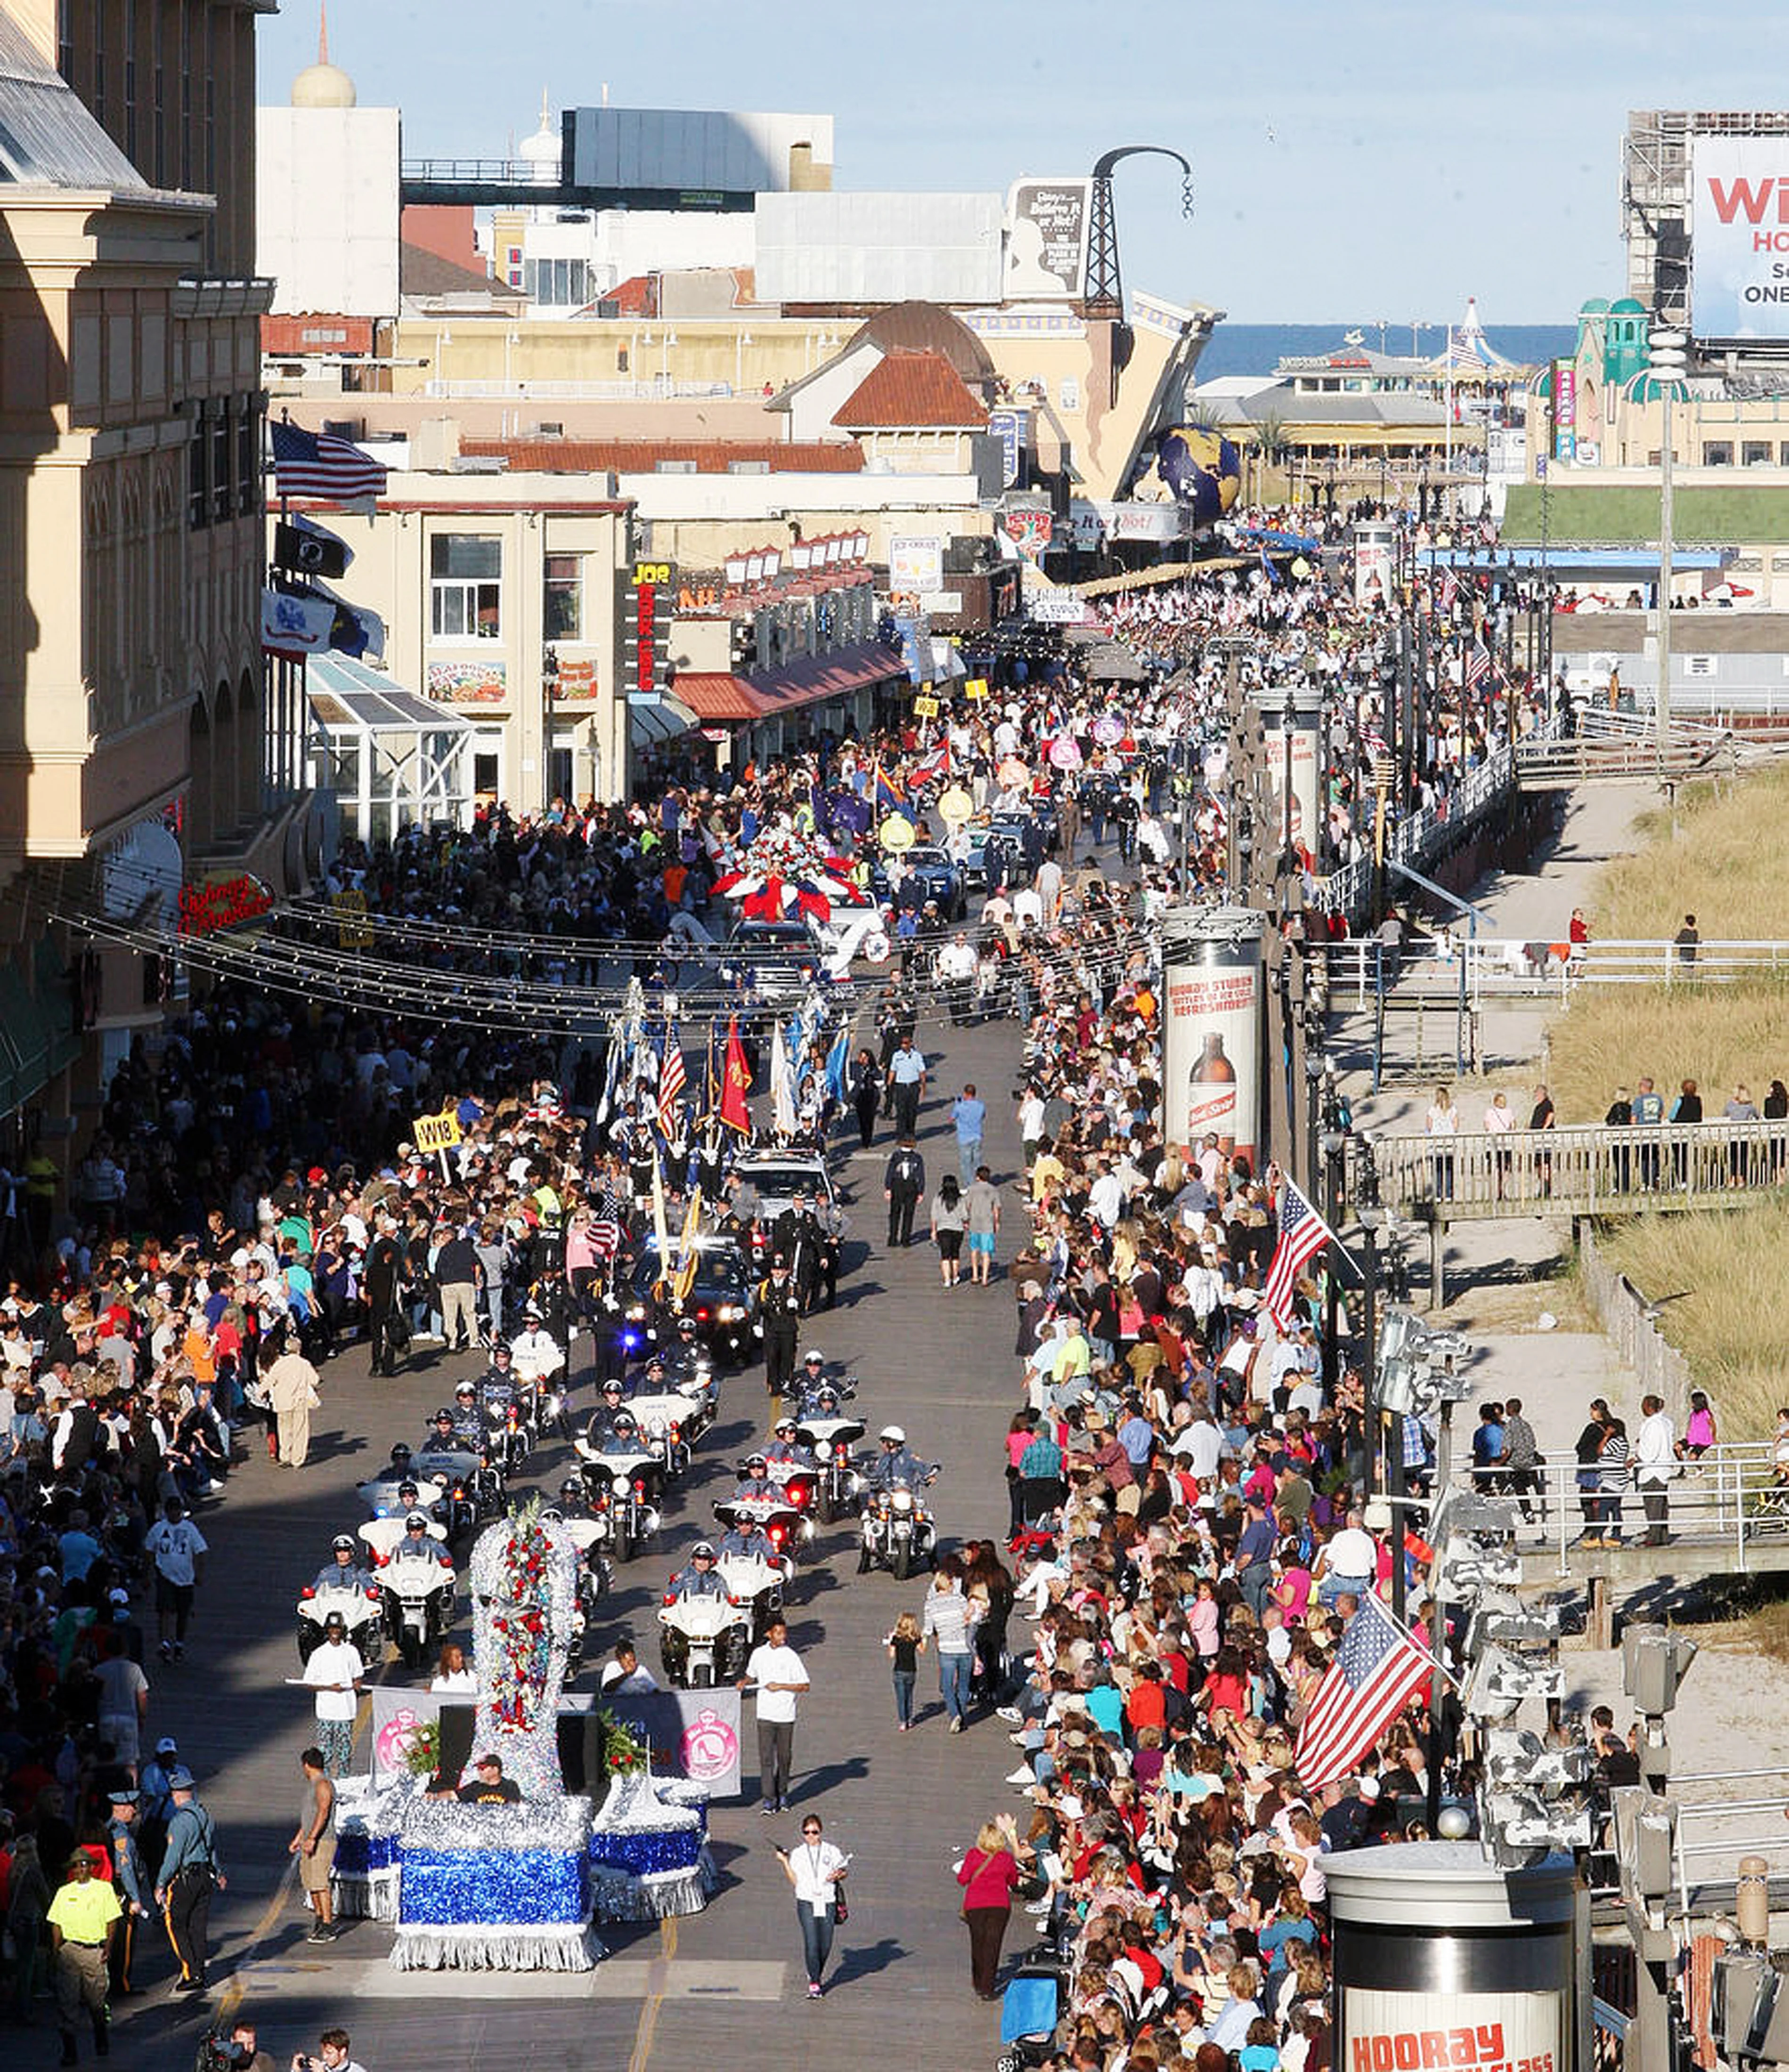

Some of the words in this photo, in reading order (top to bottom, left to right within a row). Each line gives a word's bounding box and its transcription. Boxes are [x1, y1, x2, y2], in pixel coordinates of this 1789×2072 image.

[1773, 263, 1789, 279] S
[1745, 287, 1789, 302] ONE
[1561, 372, 1571, 423] ARCADE
